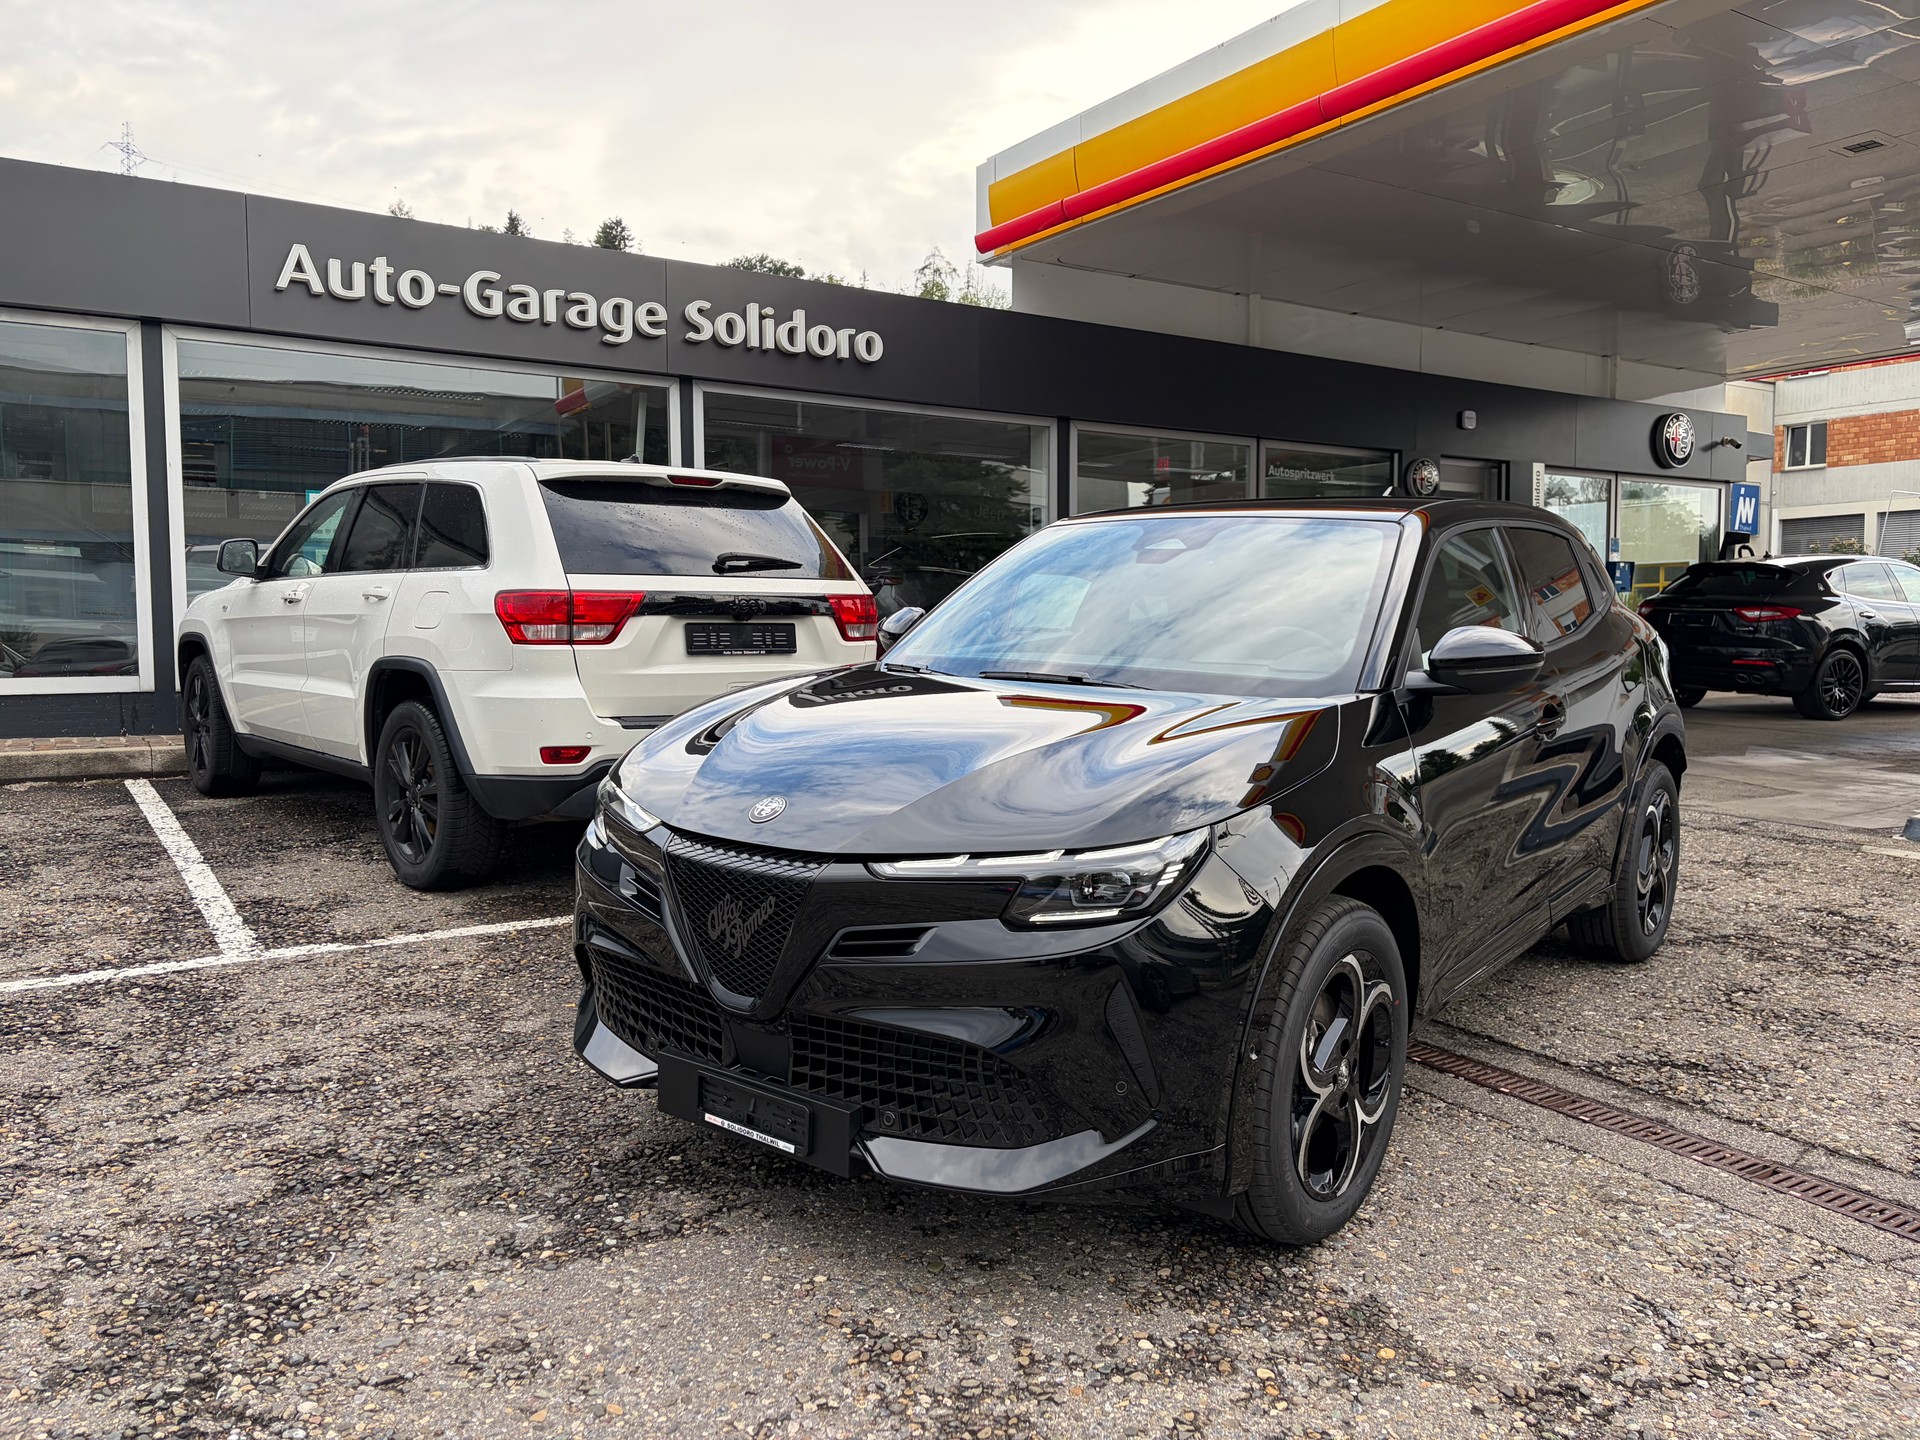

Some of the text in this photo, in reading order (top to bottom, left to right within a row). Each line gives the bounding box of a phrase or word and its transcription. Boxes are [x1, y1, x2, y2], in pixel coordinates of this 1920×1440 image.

[275, 243, 884, 363] Auto-Garage Solidoro
[1268, 464, 1336, 481] Autospritzwerk
[974, 505, 1005, 521] Jeep
[729, 596, 767, 614] Jeep
[727, 1123, 755, 1138] SOLIDORO
[755, 1133, 780, 1147] THALWIL
